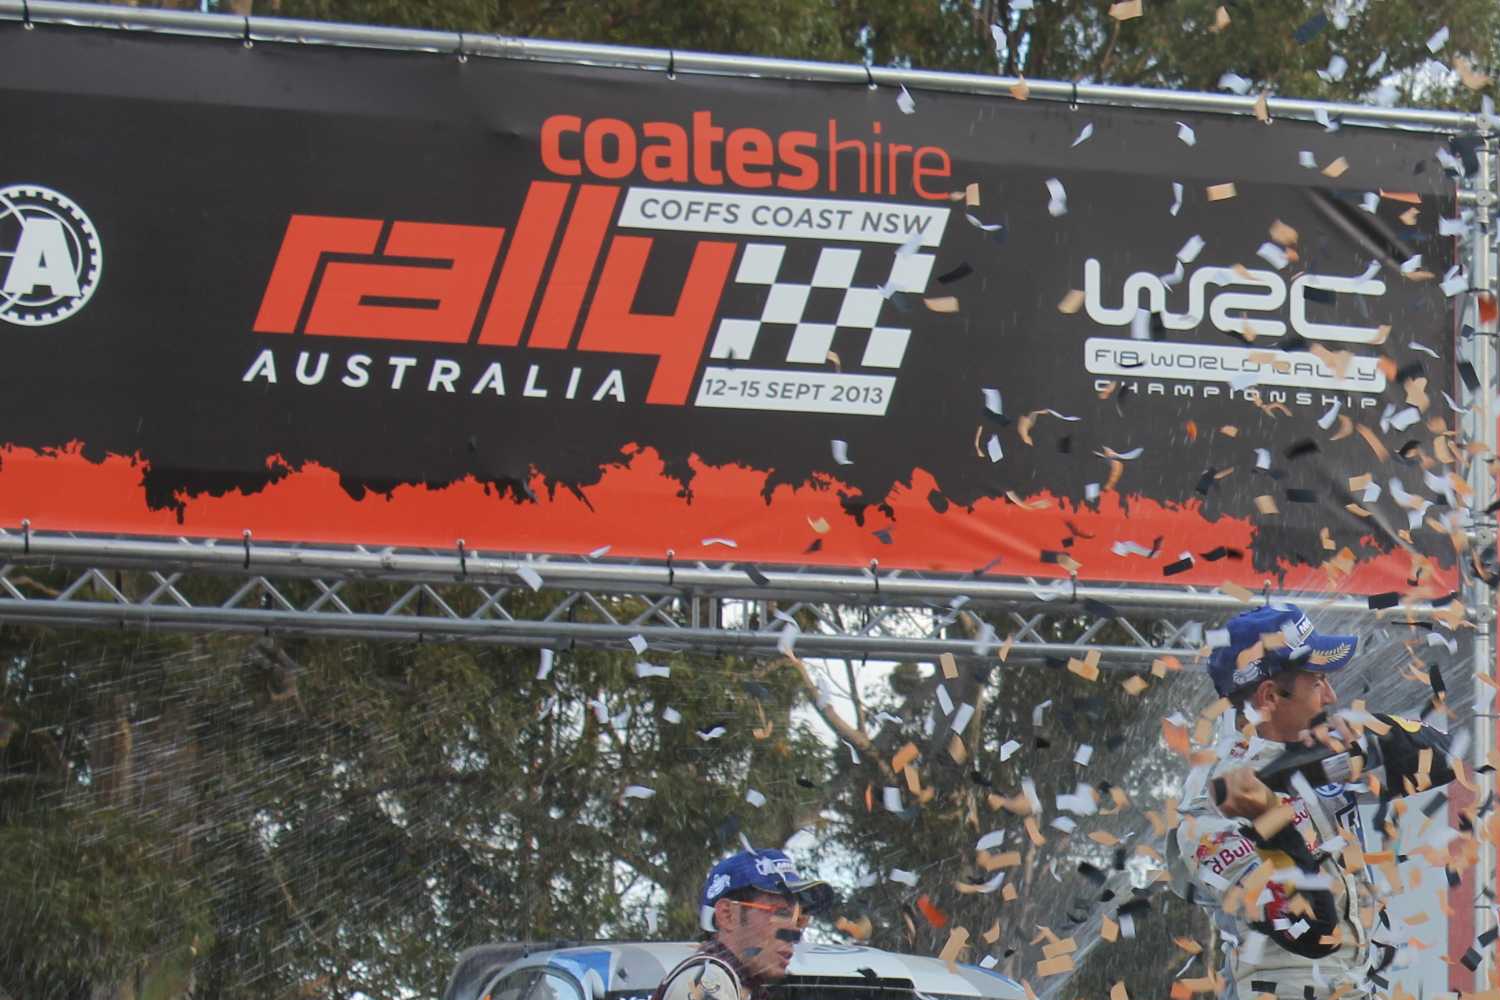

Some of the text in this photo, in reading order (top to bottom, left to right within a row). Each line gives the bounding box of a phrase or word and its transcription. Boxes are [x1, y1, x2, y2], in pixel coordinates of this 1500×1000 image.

[639, 198, 933, 236] COFFS COAST NSW
[1084, 258, 1387, 344] WRC
[242, 349, 627, 403] AUSTRALIA
[1150, 352, 1261, 373] WORLD
[765, 382, 825, 401] SEPT
[830, 385, 884, 405] 2013
[1219, 838, 1256, 868] Bull
